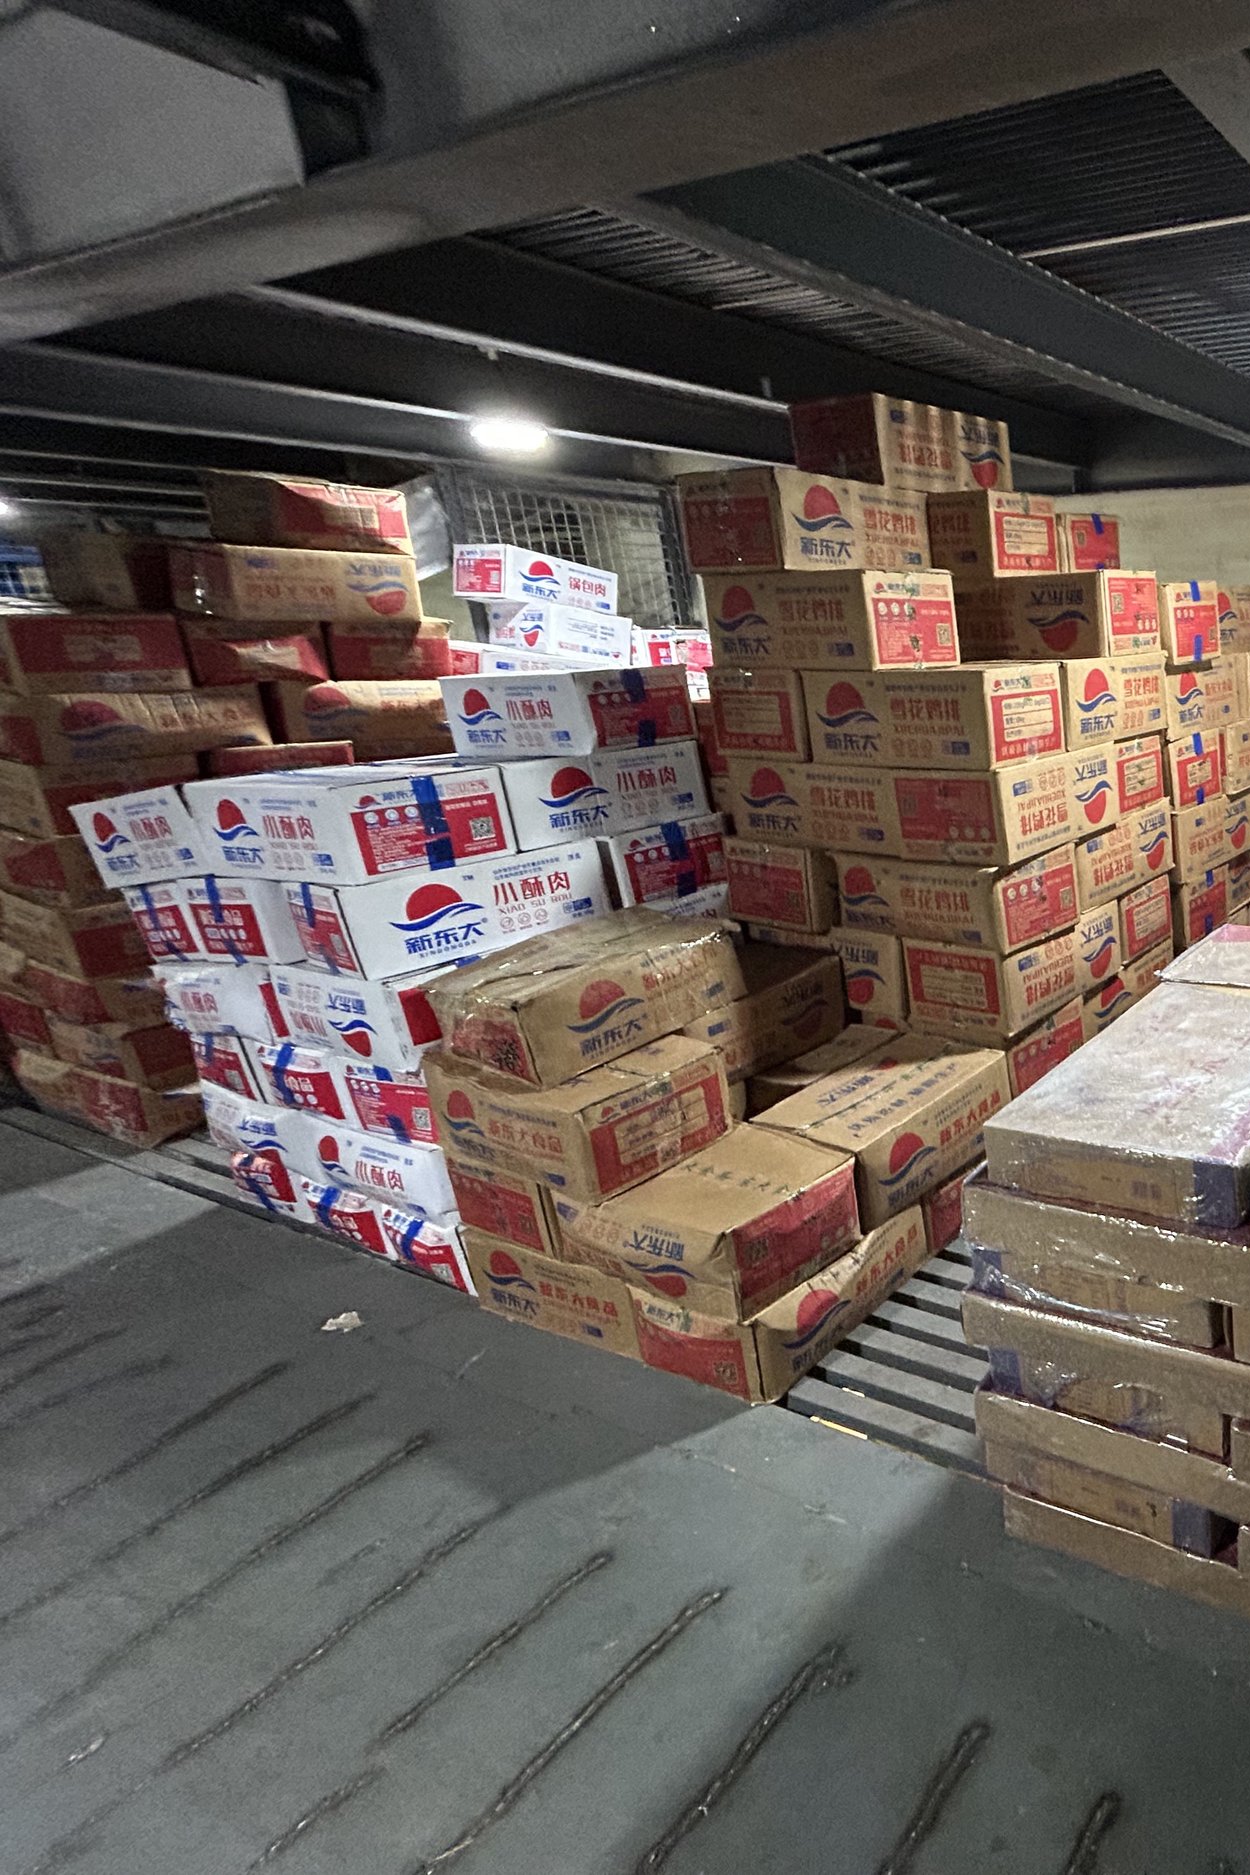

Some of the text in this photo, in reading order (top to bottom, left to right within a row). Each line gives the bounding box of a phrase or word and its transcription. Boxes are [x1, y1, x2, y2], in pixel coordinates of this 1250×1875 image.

[801, 537, 851, 559] 新东大
[521, 582, 558, 599] 新东大
[568, 576, 606, 597] 锅包肉
[505, 699, 553, 721] 小酥肉
[1081, 714, 1116, 734] 新东大
[467, 730, 507, 744] 新东大
[824, 733, 879, 752] 新东大
[616, 767, 677, 792] 小酥肉
[1075, 760, 1108, 781] 新东大
[263, 815, 314, 840] 小酥肉
[549, 806, 609, 828] 新东大
[129, 817, 172, 840] 小酥肉
[493, 872, 571, 906] 小酥肉
[405, 921, 484, 954] 新东大
[355, 1160, 404, 1192] 小酥肉
[630, 1230, 684, 1260] 新东大
[542, 1286, 616, 1315] 新东大食品
